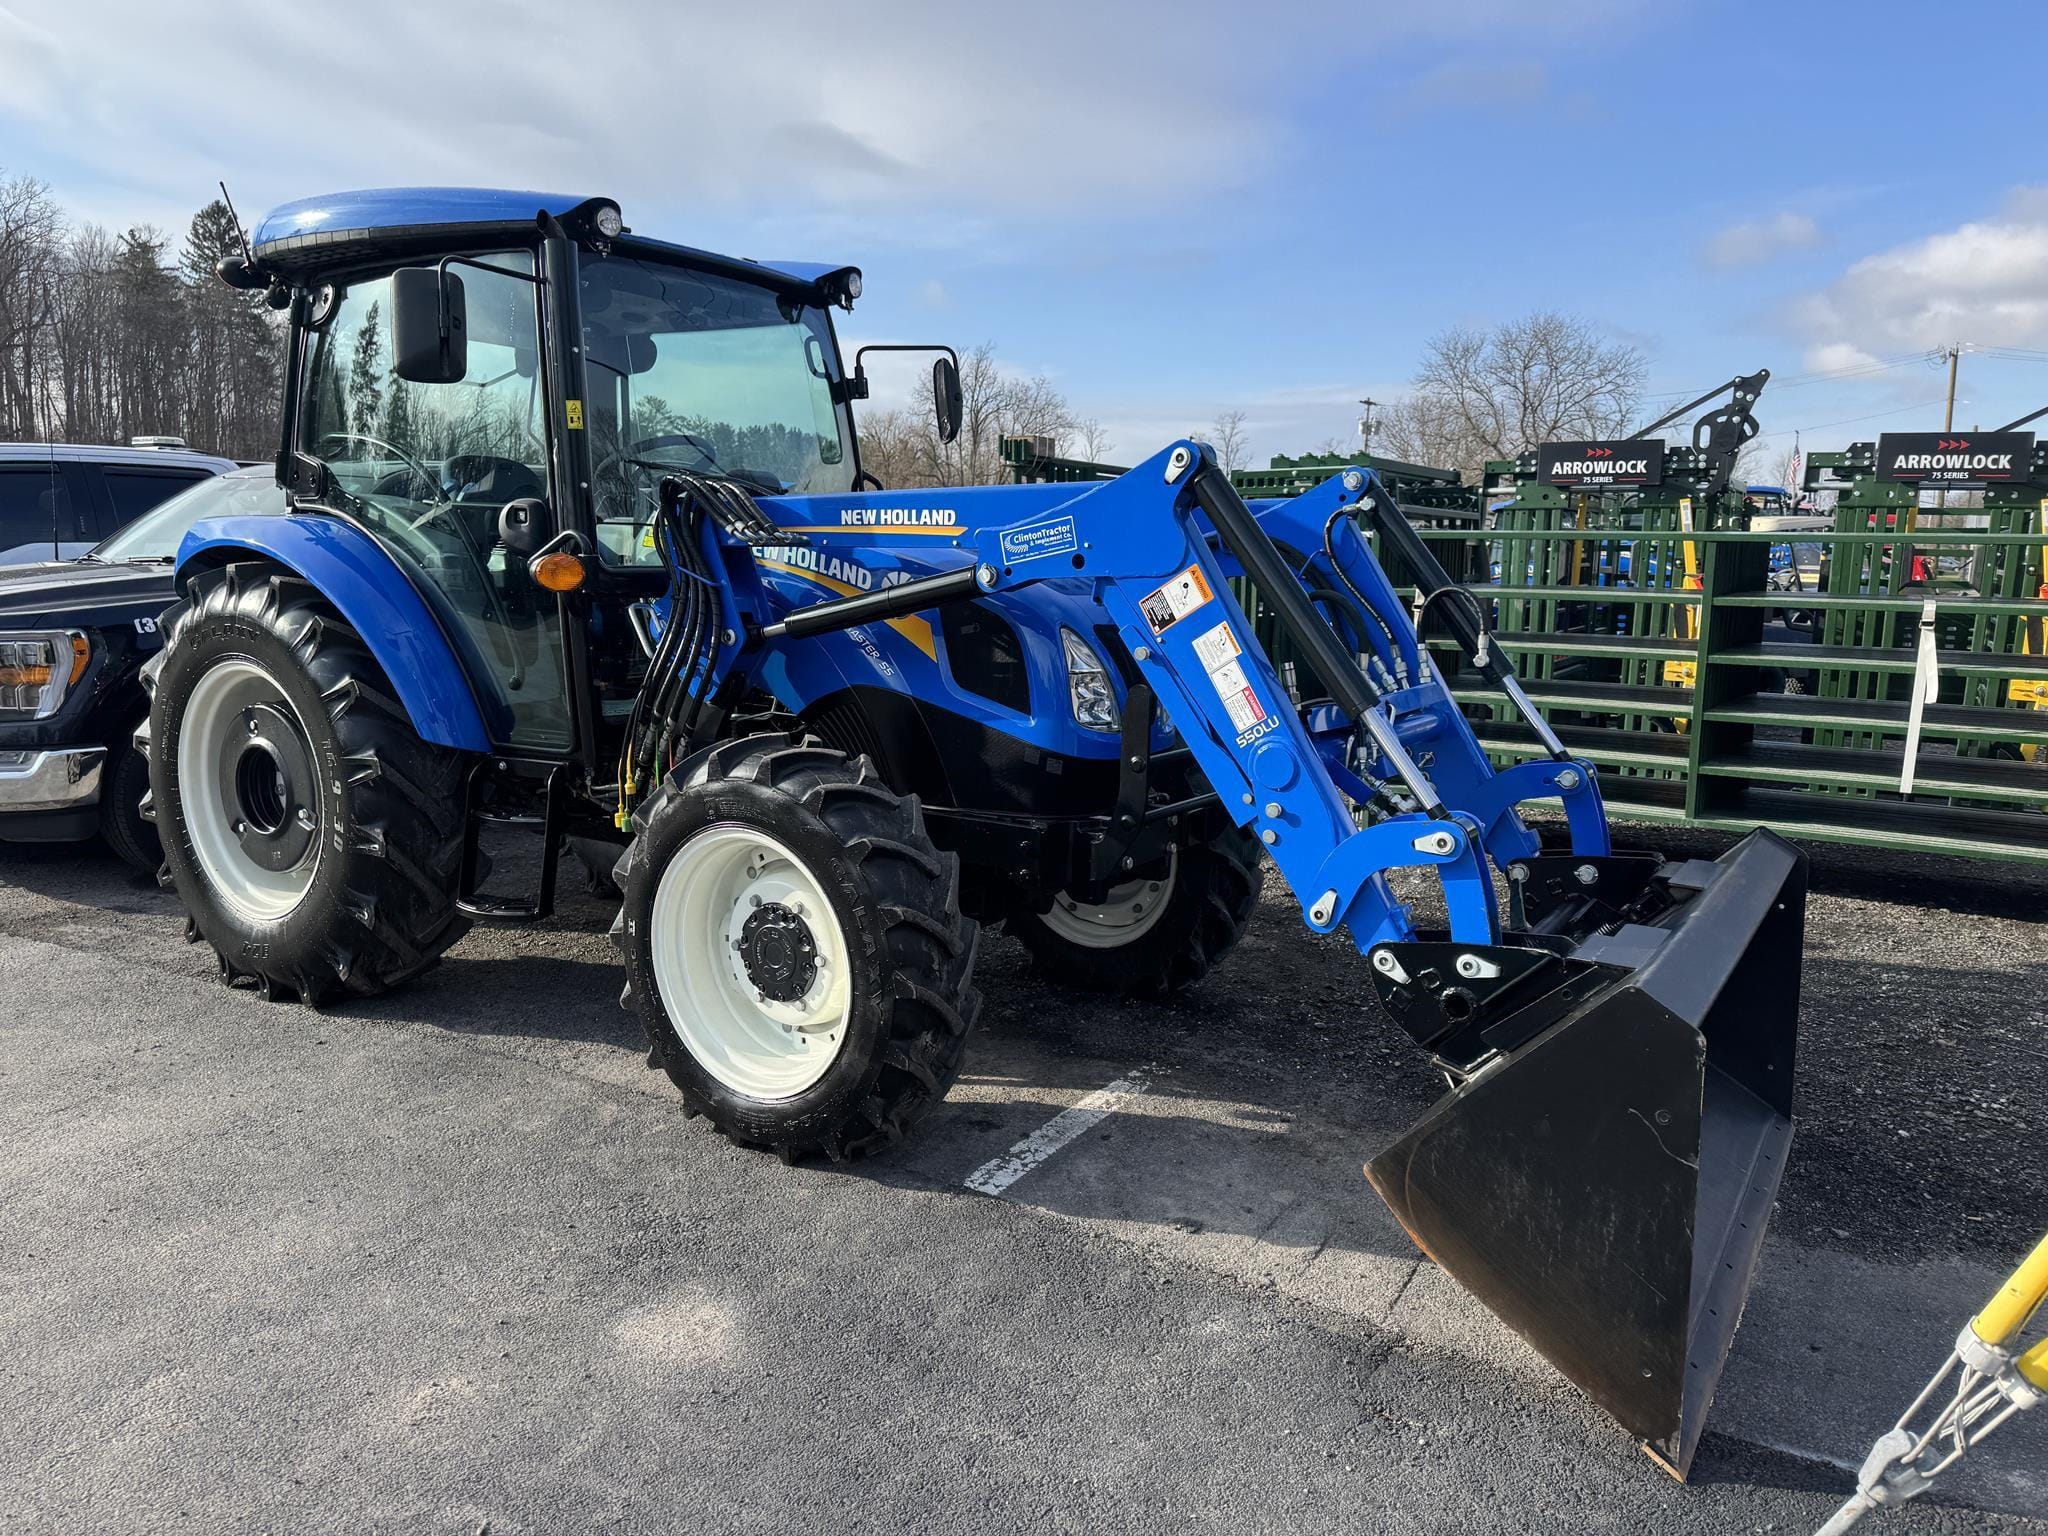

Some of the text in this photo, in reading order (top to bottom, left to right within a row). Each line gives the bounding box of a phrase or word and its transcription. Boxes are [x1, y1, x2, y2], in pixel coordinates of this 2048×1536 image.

[1551, 460, 1648, 475] ARROWLOCK
[1893, 454, 2013, 469] ARROWLOCK
[1583, 476, 1591, 484] 75
[841, 509, 956, 526] NEW HOLLAND
[752, 546, 872, 590] EW HOLLAND
[133, 617, 157, 634] (3
[878, 661, 895, 677] 55
[1235, 714, 1280, 749] 550LU
